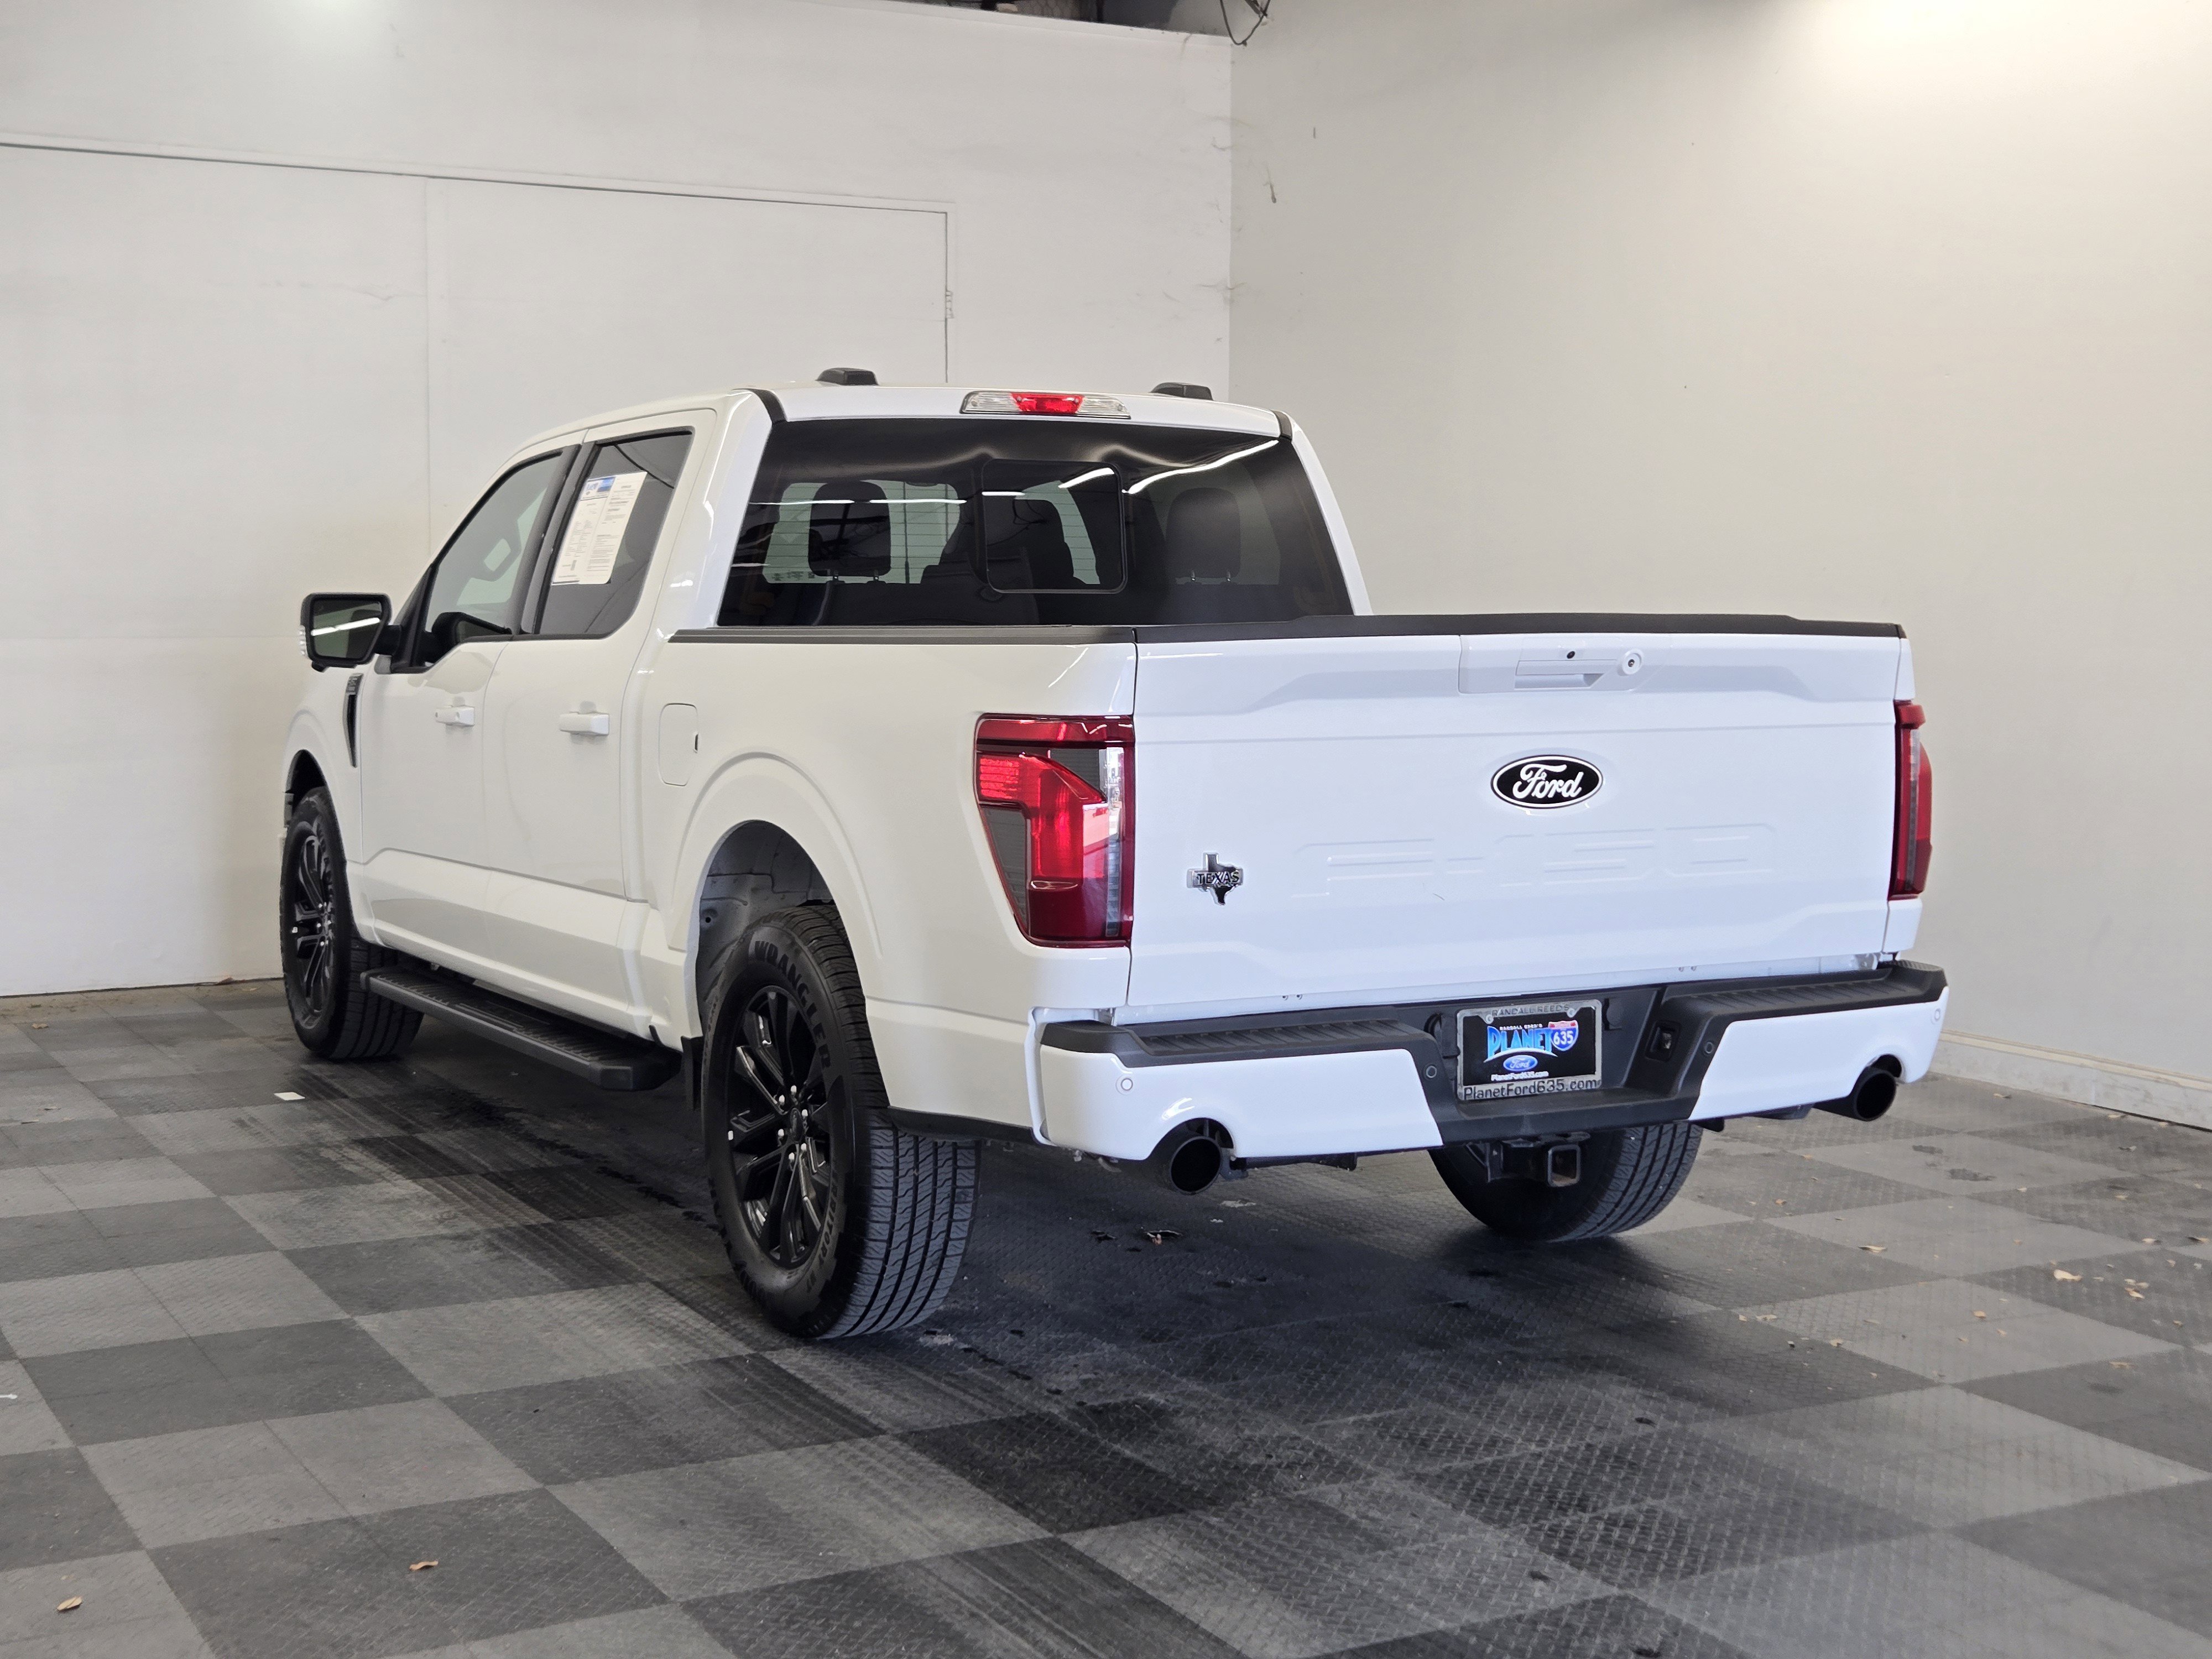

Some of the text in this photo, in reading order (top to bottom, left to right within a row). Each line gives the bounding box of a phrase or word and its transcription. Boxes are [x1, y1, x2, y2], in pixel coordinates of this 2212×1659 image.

[1512, 764, 1584, 799] Ford
[1197, 871, 1239, 884] TEXAS
[755, 941, 831, 1070] WRANGLER
[1491, 1007, 1534, 1016] RANDALL
[1487, 1026, 1552, 1058] PLANET
[1553, 1030, 1574, 1045] 635
[1510, 1057, 1530, 1069] Ford
[1464, 1079, 1597, 1099] PlanetFord635.com
